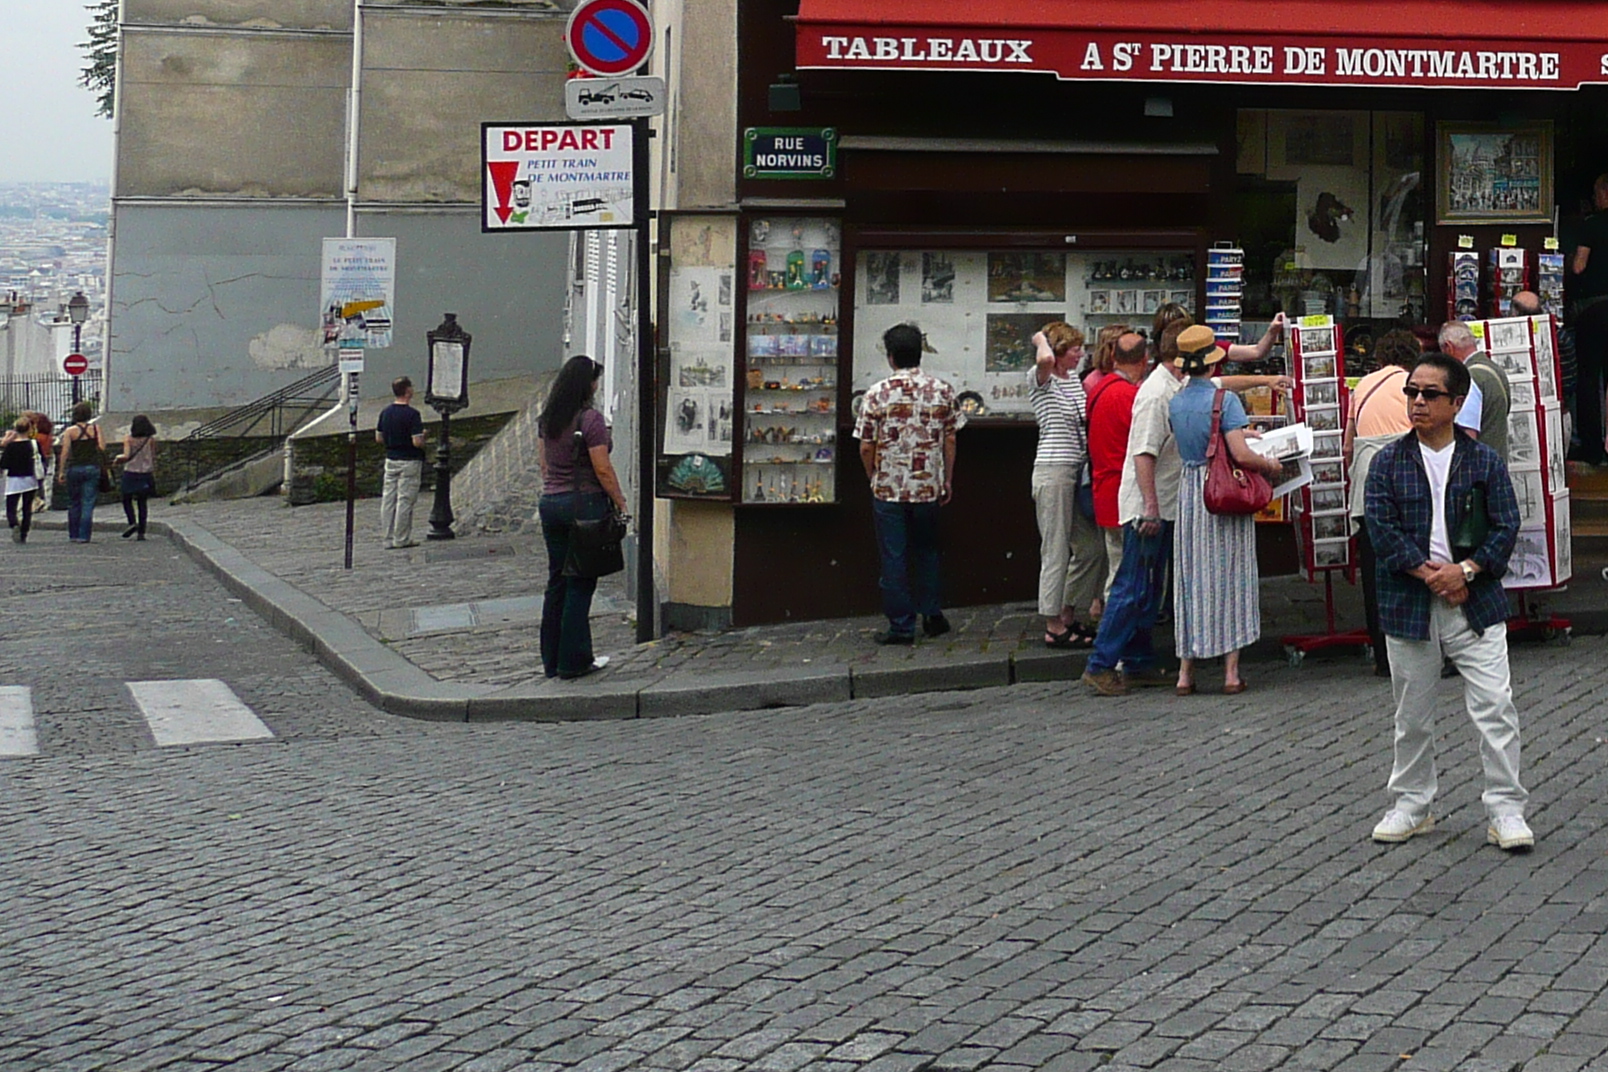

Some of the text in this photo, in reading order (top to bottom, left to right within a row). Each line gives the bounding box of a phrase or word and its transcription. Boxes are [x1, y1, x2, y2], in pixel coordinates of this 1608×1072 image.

[821, 36, 1033, 64] TABLEAUX
[1080, 42, 1104, 71] A
[1150, 43, 1274, 75] PIERRE
[1283, 47, 1326, 76] DE
[1335, 47, 1560, 80] MONTMARTRE
[503, 128, 616, 152] DEPART
[774, 137, 804, 150] RUE
[527, 158, 597, 170] PETIT TRAIN
[756, 154, 823, 167] NORVINS
[528, 171, 631, 184] DE MONTMARTRE
[1218, 284, 1240, 292] PARIS
